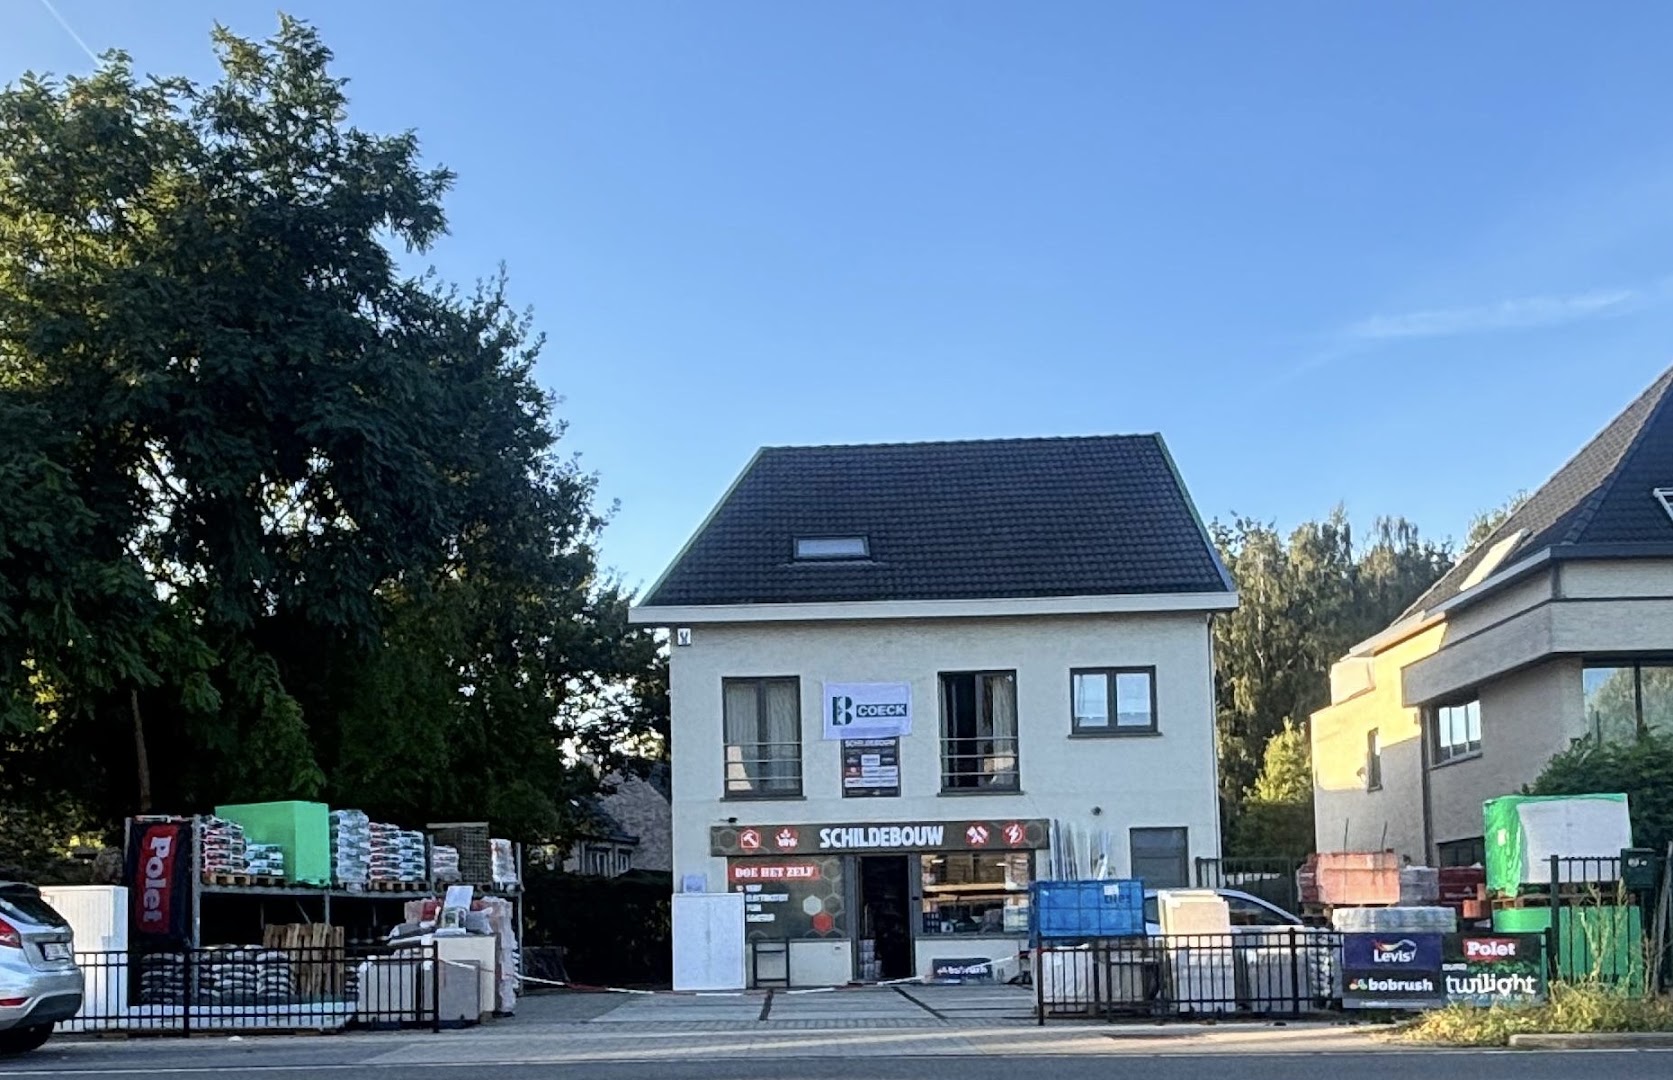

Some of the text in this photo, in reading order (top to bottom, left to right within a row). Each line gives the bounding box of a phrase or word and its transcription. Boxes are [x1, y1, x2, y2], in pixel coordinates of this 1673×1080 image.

[857, 705, 906, 716] COECK
[820, 826, 944, 848] SCHILDEBOUW
[143, 836, 172, 922] Polet
[735, 866, 814, 878] DOE HET ZELF
[1467, 941, 1516, 956] Polet
[1373, 949, 1411, 963] Levis
[1368, 978, 1433, 991] bobrush
[1445, 973, 1537, 997] twilight
